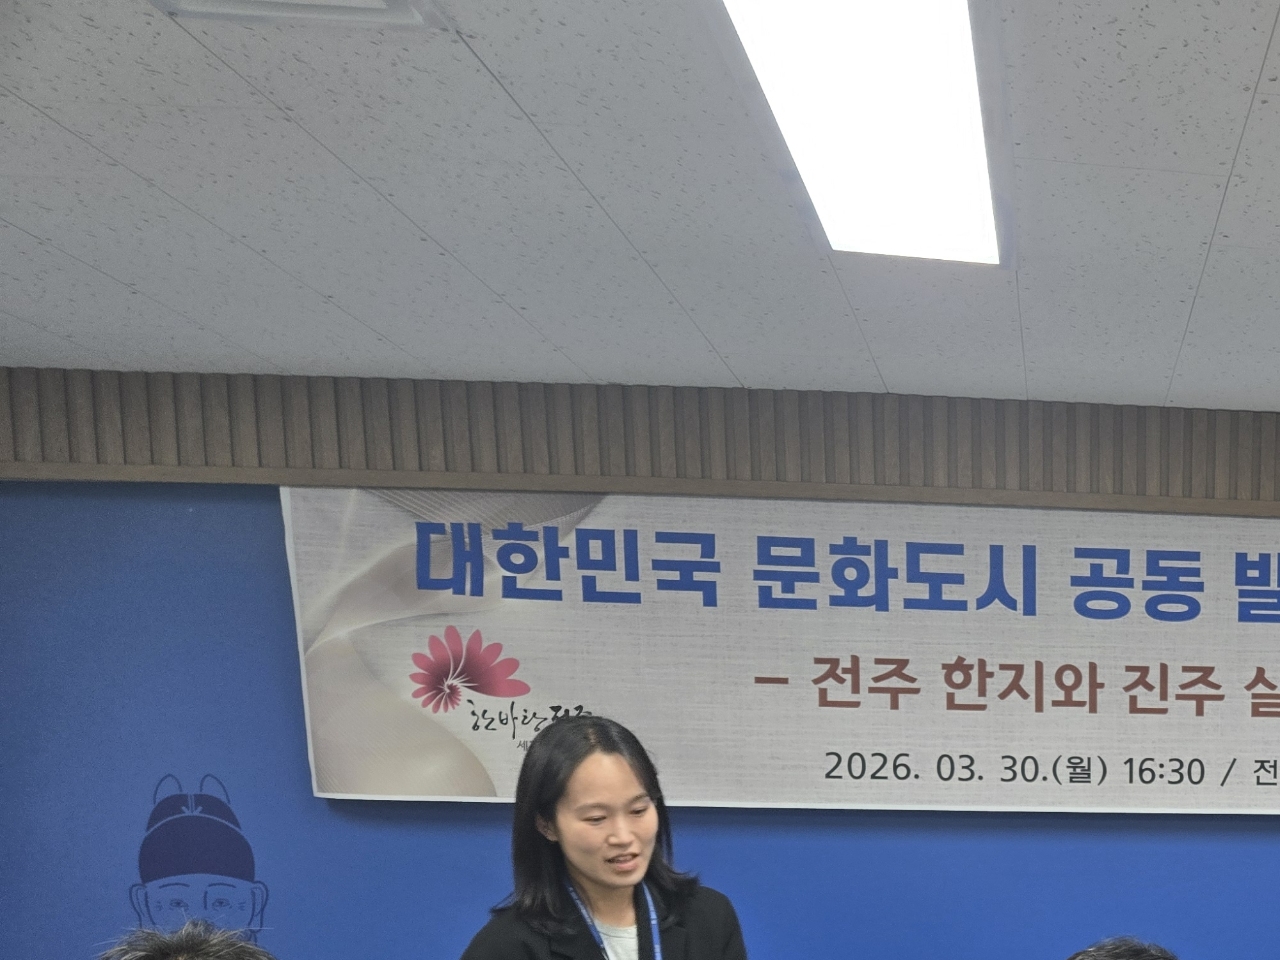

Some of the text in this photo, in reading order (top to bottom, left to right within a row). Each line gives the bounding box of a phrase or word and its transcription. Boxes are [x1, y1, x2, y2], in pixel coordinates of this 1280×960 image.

[416, 522, 721, 607] 대한민국
[753, 536, 1037, 616] 문화도시
[1070, 548, 1204, 622] 공동
[812, 656, 921, 709] 전주
[941, 657, 1105, 713] 한지와
[1123, 664, 1225, 715] 진주
[824, 751, 920, 781] 2026.
[936, 753, 984, 782] 03.
[1000, 754, 1108, 787] 30.(월)
[1123, 757, 1206, 786] 16:30
